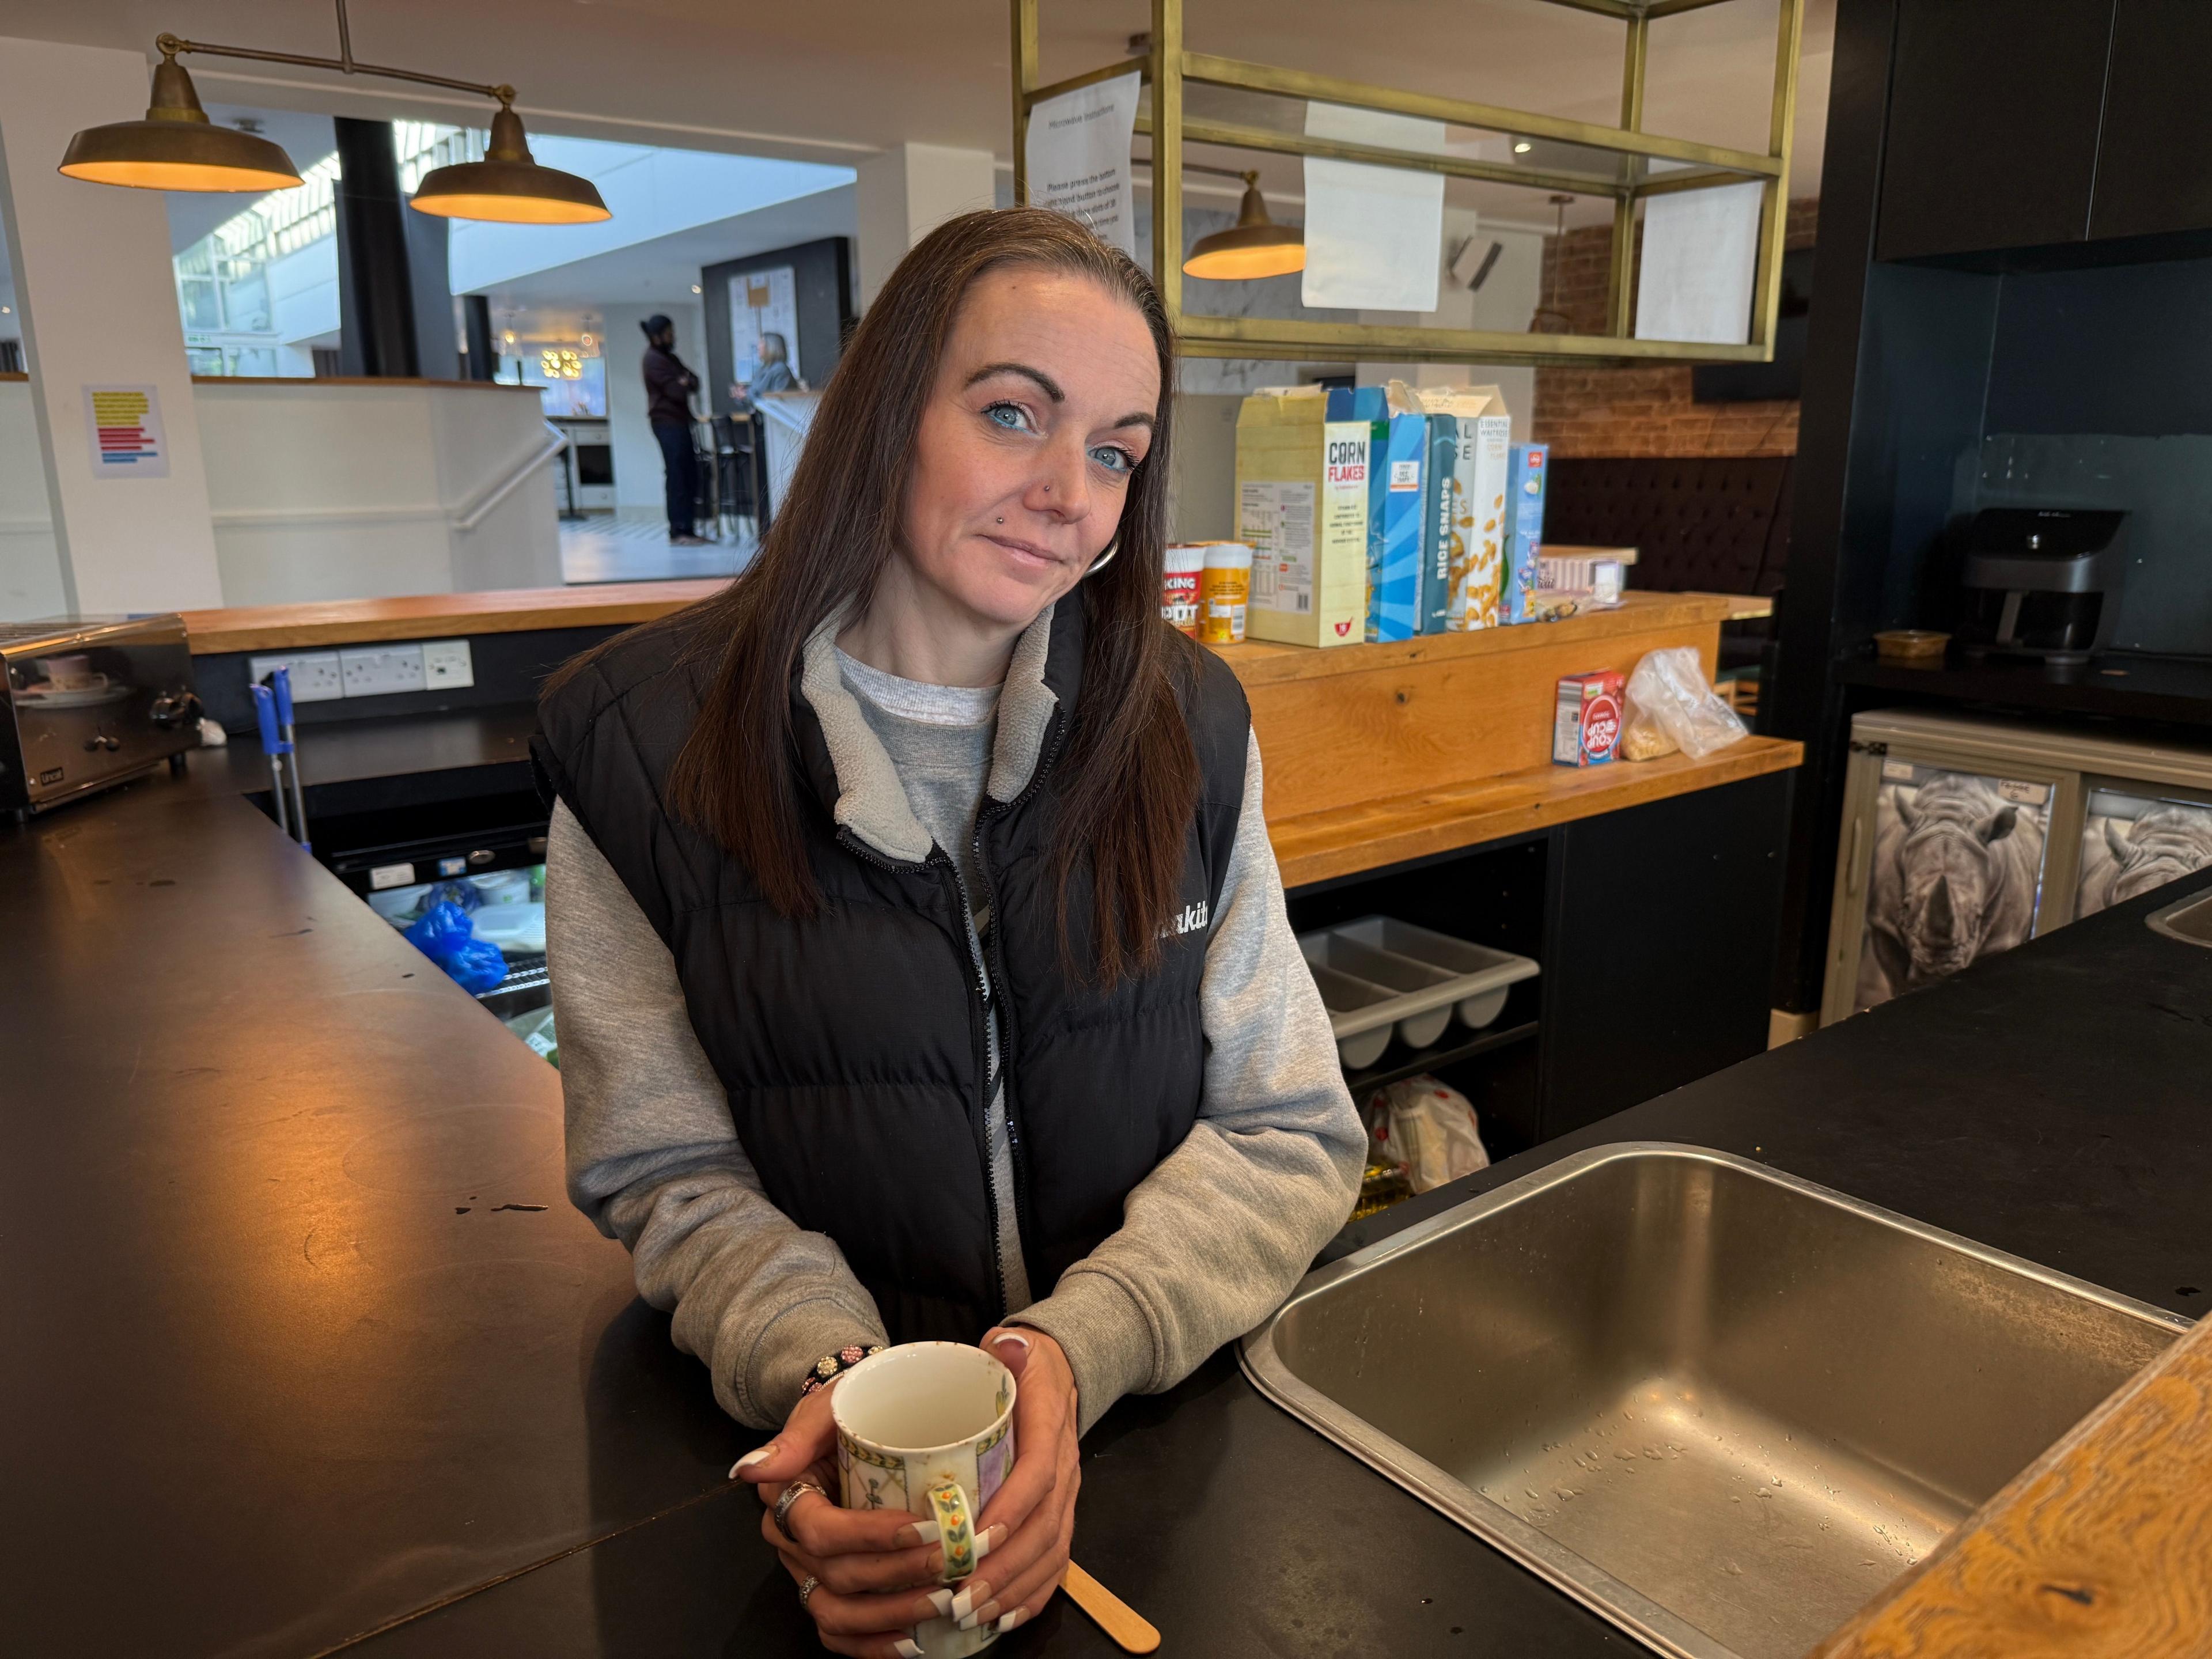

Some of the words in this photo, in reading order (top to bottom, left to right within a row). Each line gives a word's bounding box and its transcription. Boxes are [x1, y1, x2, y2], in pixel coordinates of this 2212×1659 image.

[1047, 182, 1069, 192] Please
[1480, 419, 1508, 429] ESSENTIAL
[1480, 429, 1508, 438] WAITROSE
[1328, 441, 1365, 465] CORN
[1328, 465, 1365, 483] FLAKES
[1439, 478, 1452, 536] SNAPS
[1437, 539, 1449, 579] RICE
[1165, 577, 1196, 590] KING
[1588, 721, 1606, 736] CUP
[1587, 735, 1611, 749] SOUP
